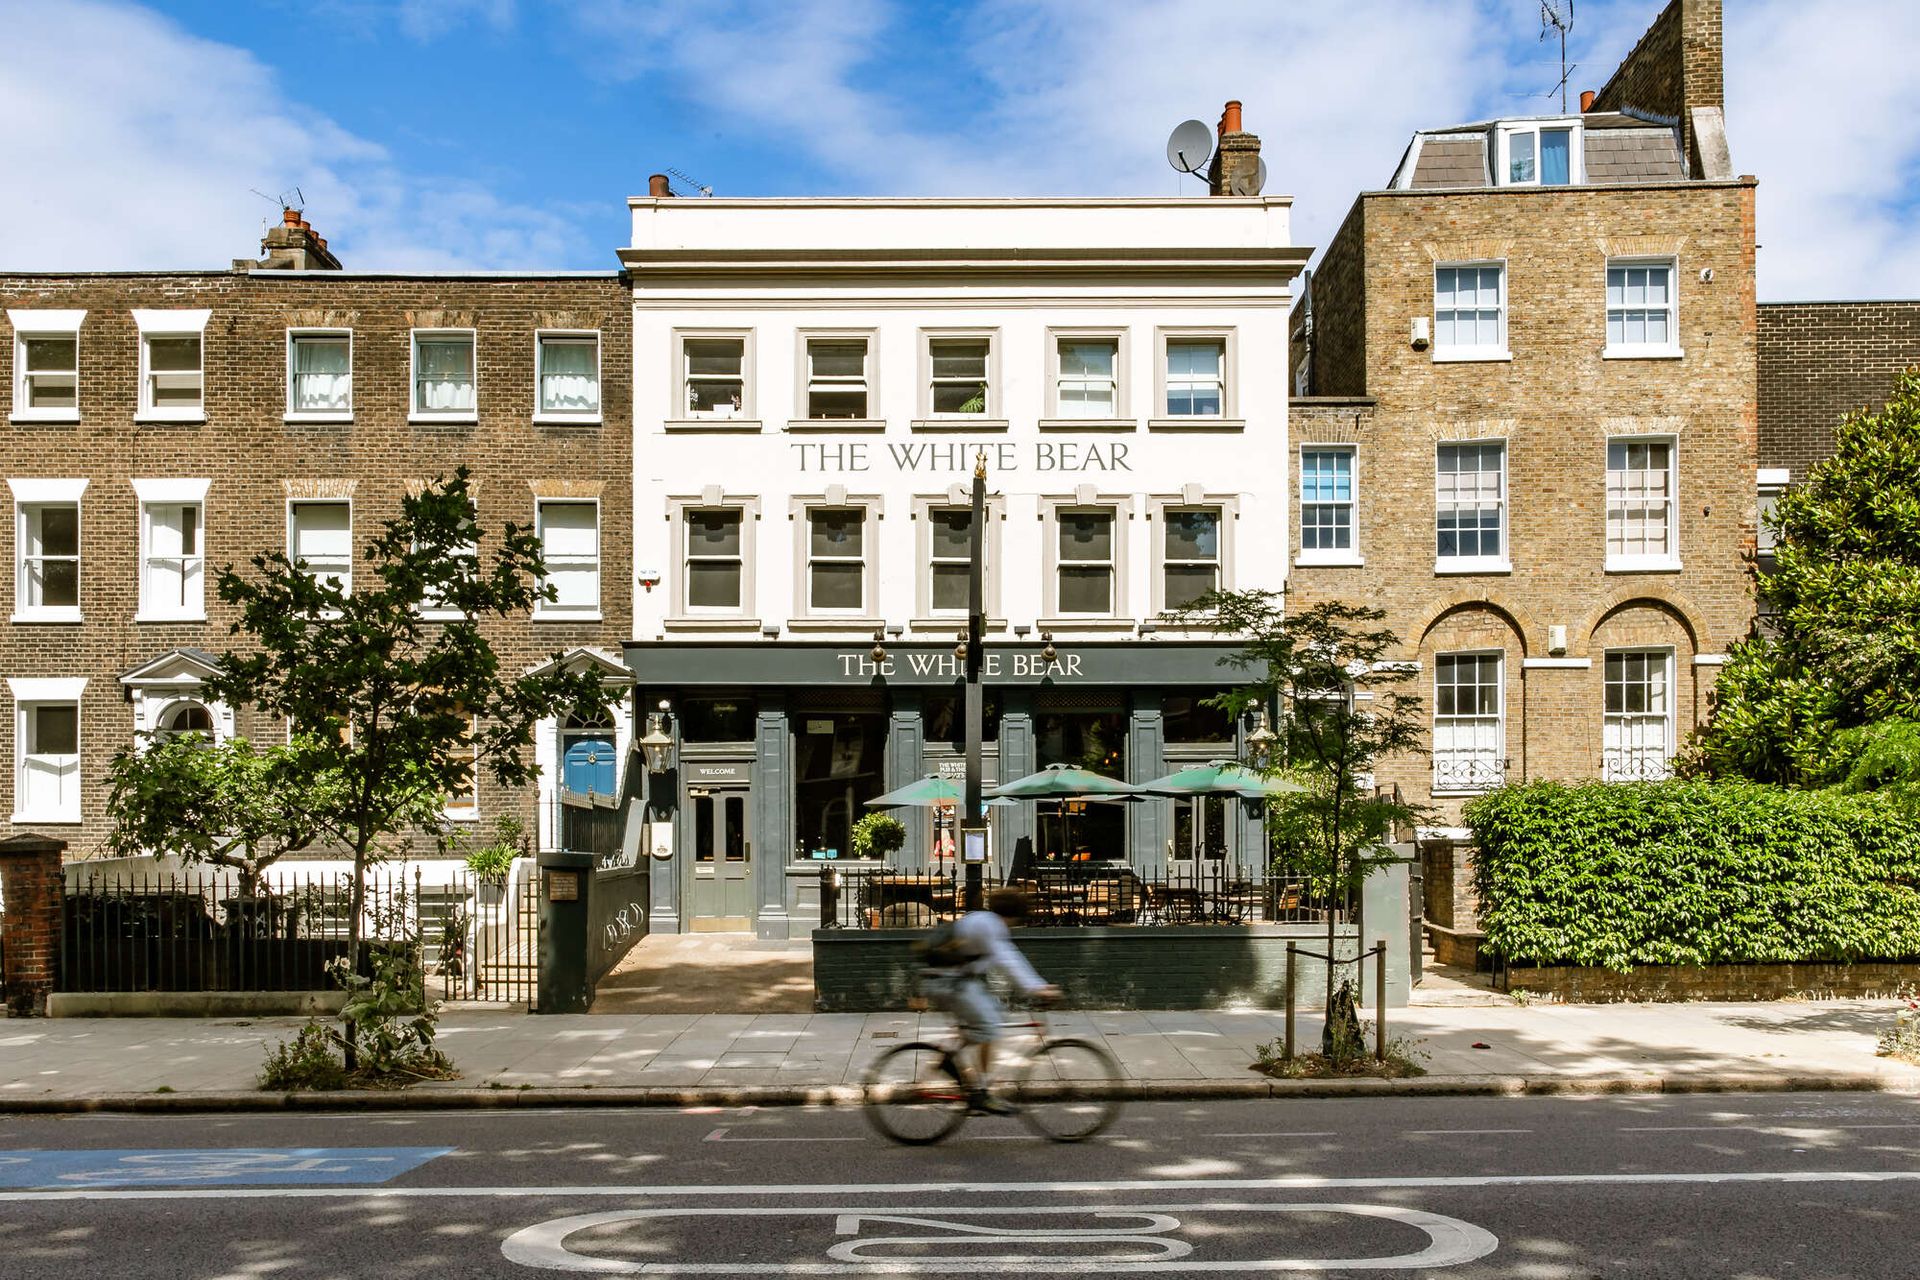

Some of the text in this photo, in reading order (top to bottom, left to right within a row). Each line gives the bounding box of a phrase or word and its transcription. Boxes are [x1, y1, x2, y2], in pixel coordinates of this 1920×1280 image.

[790, 442, 1133, 472] THE WHITE BEAR
[837, 653, 1084, 677] THE WHIE BEAR
